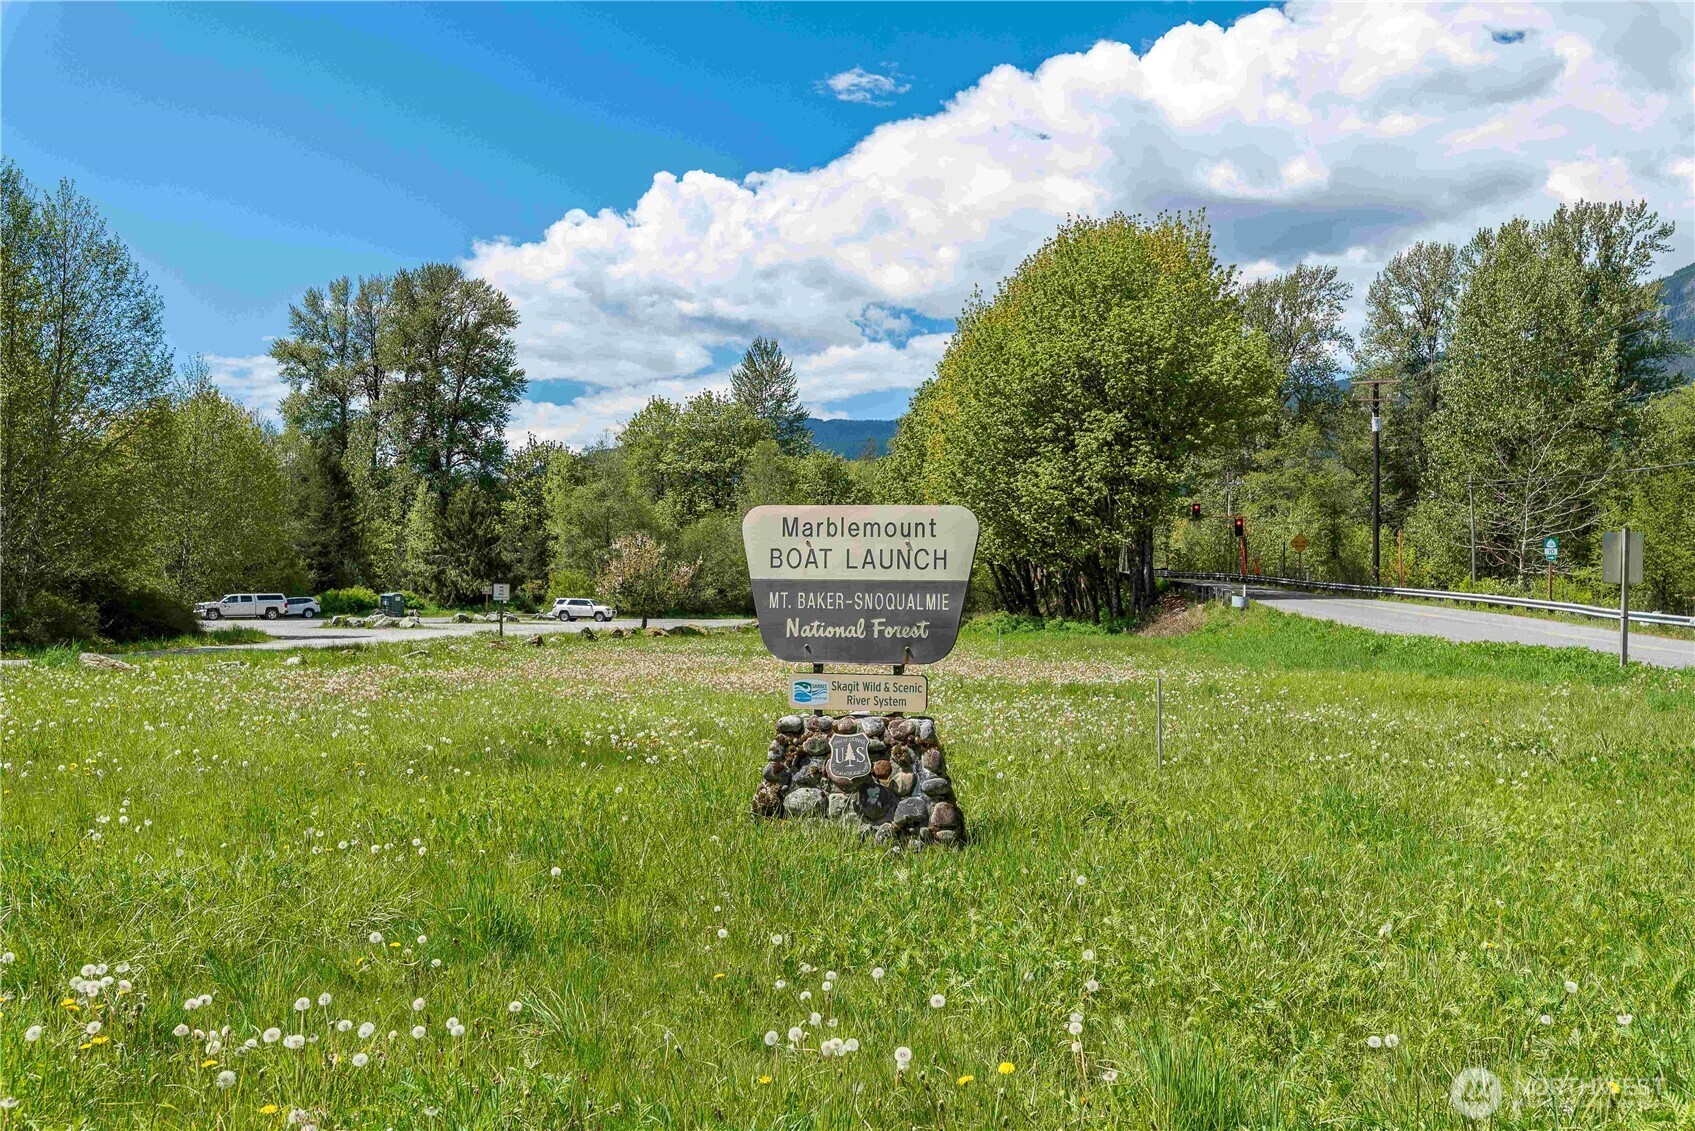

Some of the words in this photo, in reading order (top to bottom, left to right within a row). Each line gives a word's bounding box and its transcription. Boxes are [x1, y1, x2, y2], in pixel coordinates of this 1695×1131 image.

[782, 516, 937, 538] Marblemount
[770, 548, 833, 569] BOAT
[846, 548, 948, 570] LAUNCH
[769, 592, 792, 609] MT.
[797, 592, 950, 611] BAKER-SNOQUALMIE
[786, 617, 866, 639] National
[871, 618, 930, 639] Forest
[831, 681, 860, 694] Skagit
[862, 681, 881, 692] Wild
[884, 682, 890, 692] &
[893, 682, 923, 693] Scenic
[847, 695, 870, 706] River
[873, 696, 907, 708] System
